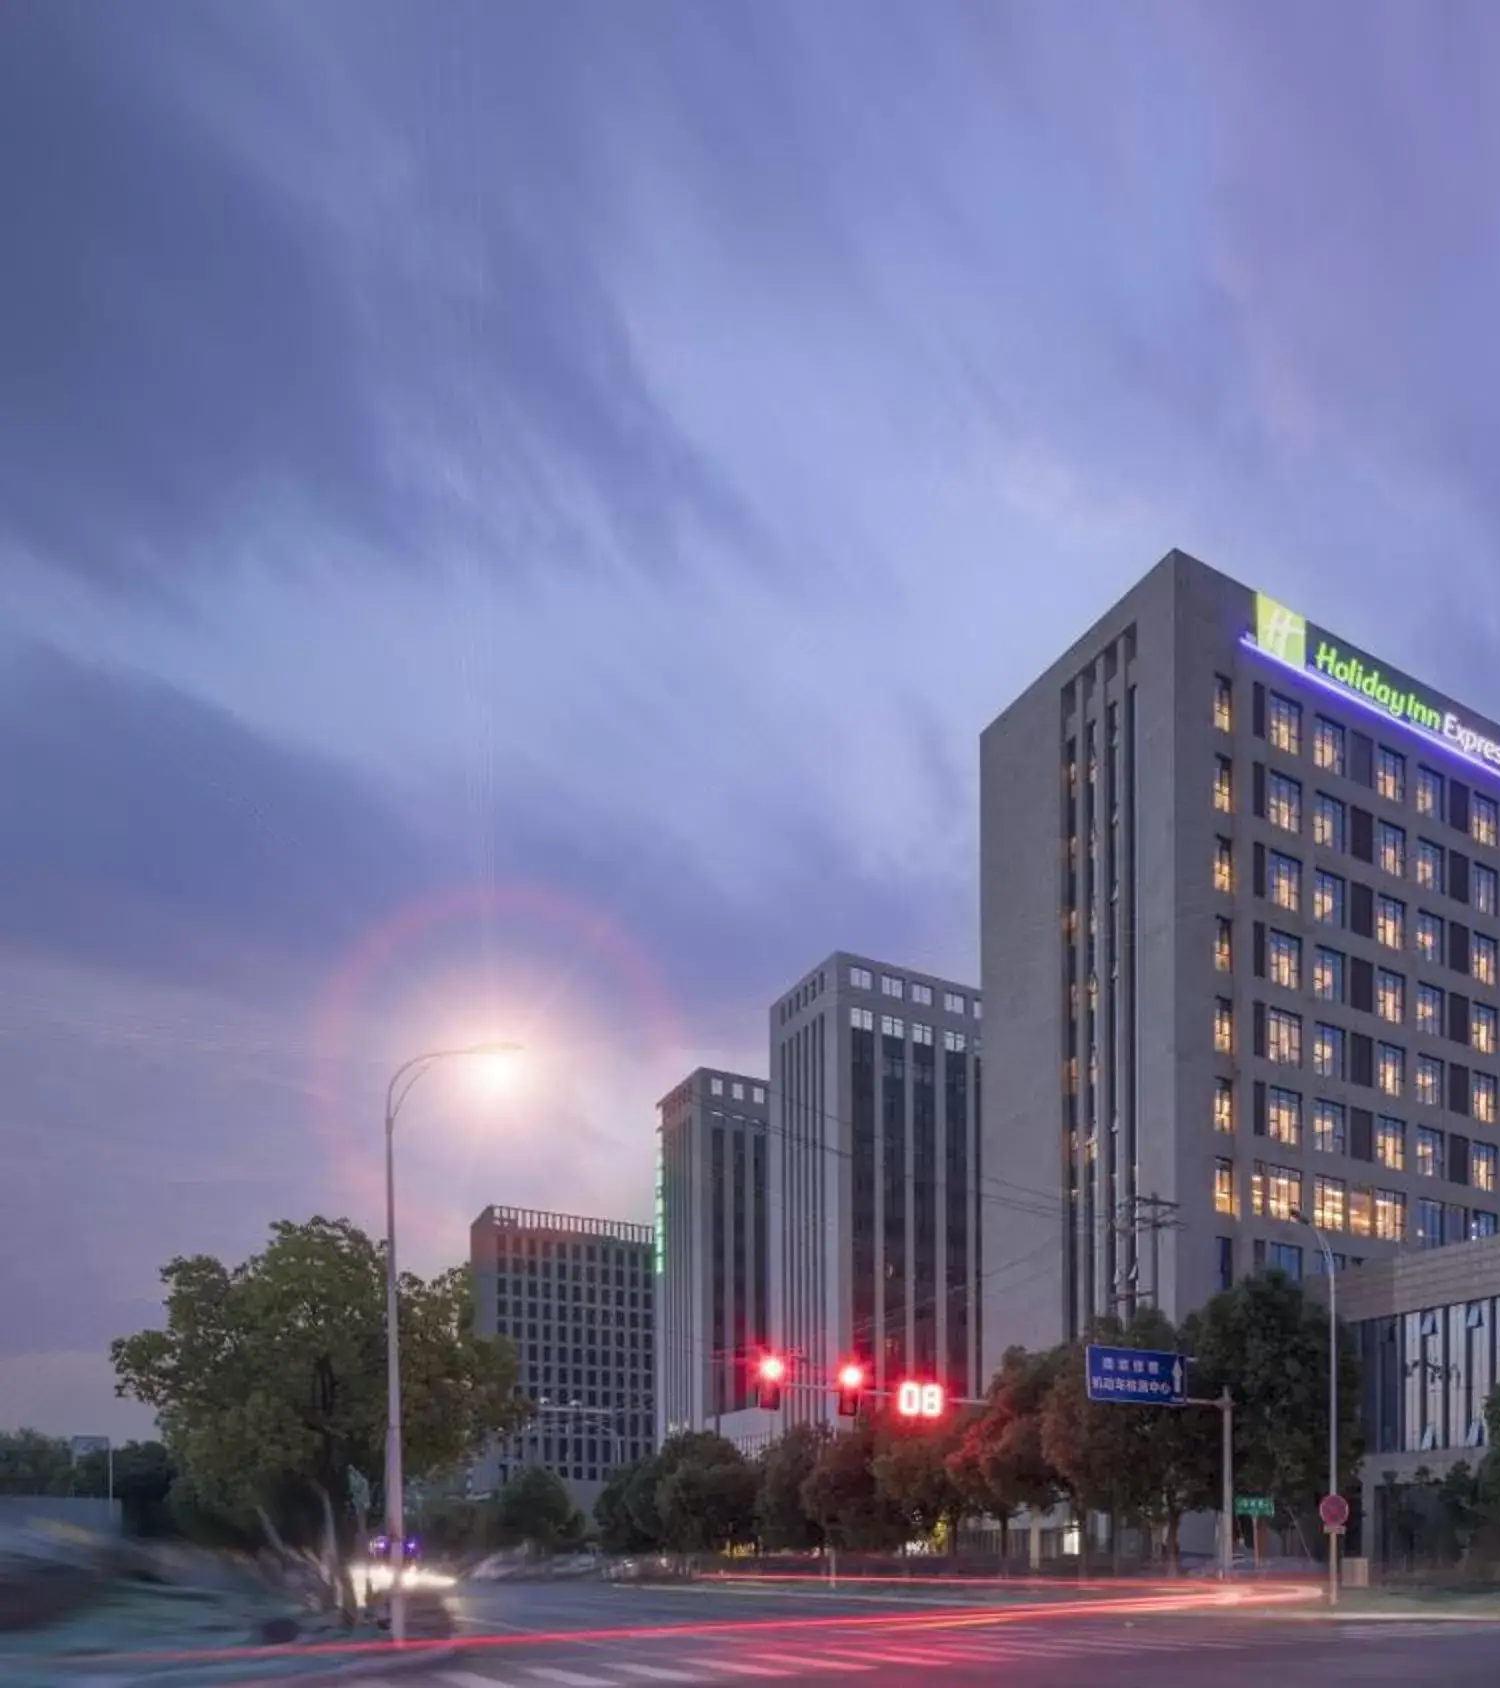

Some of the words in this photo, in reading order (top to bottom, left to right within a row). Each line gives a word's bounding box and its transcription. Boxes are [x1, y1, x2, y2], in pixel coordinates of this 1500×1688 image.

[1315, 642, 1404, 716] Holiday
[1406, 694, 1441, 731] Inn
[899, 1381, 943, 1417] 08
